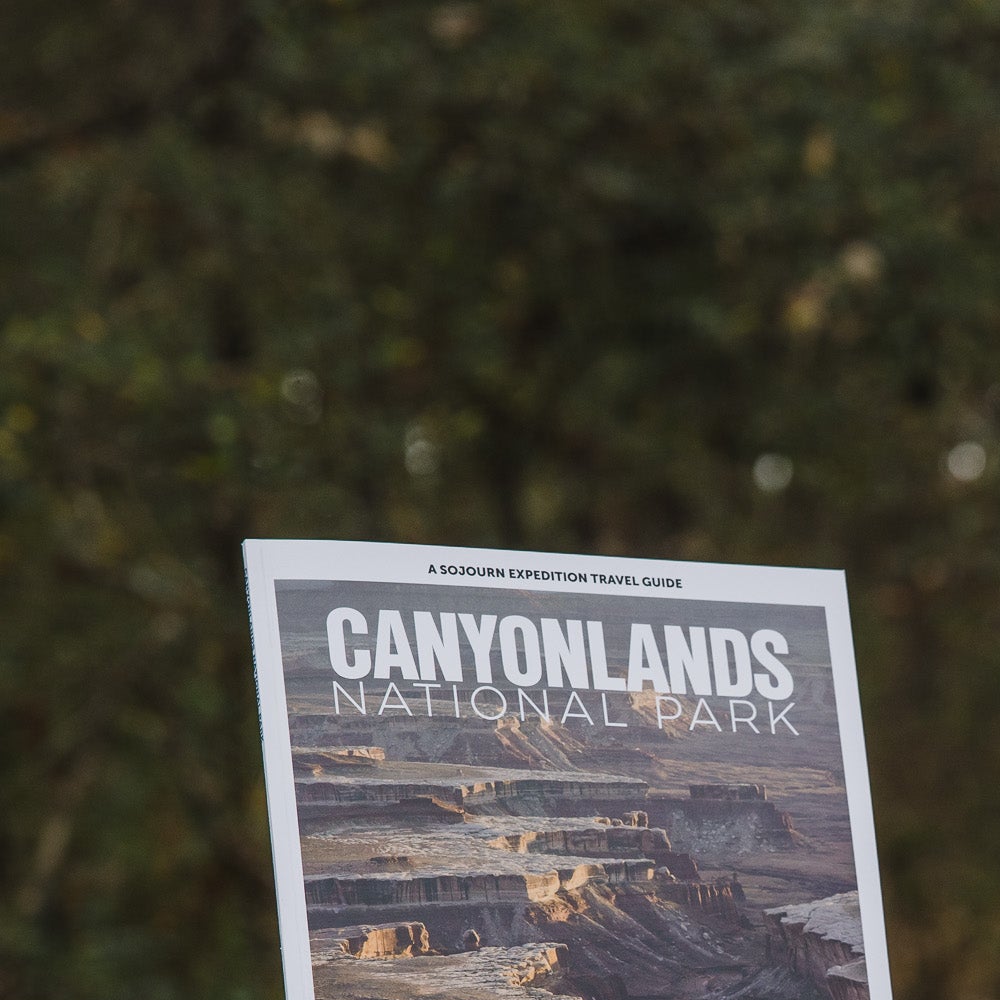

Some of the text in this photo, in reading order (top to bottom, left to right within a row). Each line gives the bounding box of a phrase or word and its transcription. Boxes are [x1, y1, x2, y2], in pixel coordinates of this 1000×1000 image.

[428, 565, 682, 588] A SOJOURN EXPEDITION TRAVEL GUIDE
[326, 607, 794, 700] CANYONLANDS
[332, 681, 799, 736] NATIONAL PARK
